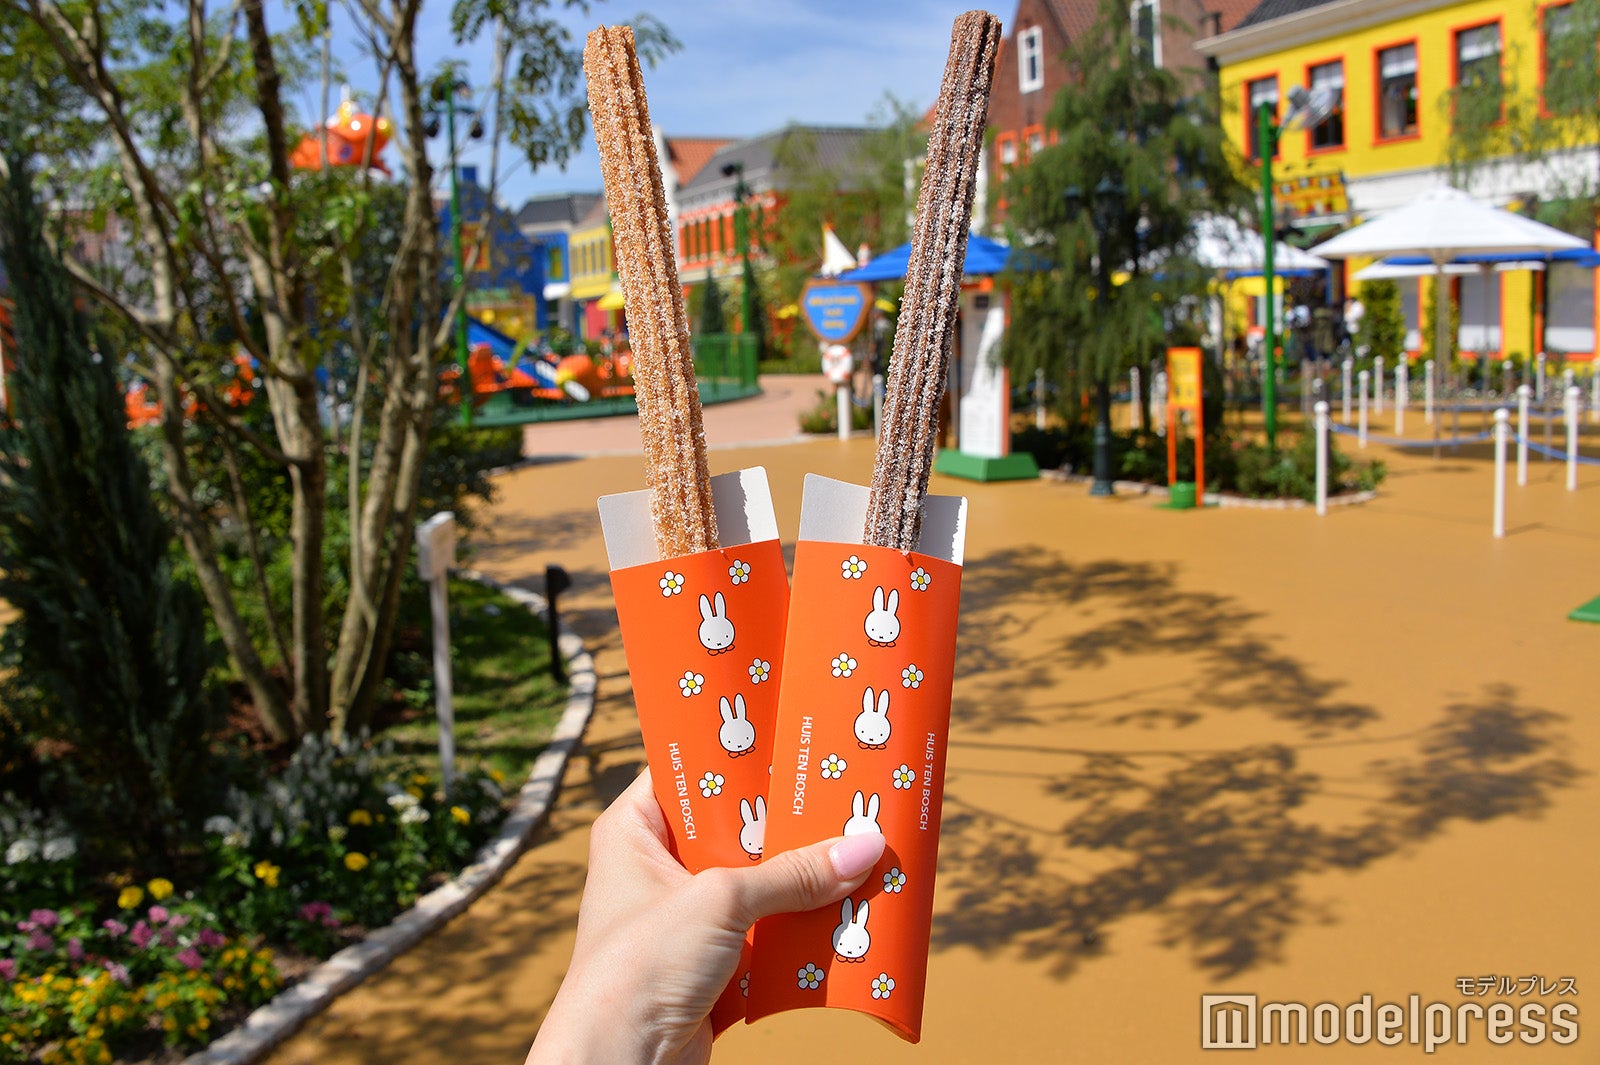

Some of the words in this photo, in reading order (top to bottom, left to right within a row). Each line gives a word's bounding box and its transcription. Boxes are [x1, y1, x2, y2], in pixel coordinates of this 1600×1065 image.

[801, 716, 813, 745] HUIS
[668, 742, 684, 771] HUIS
[797, 747, 809, 771] TEN
[925, 732, 936, 761] HUIS
[675, 772, 689, 797] TEN
[923, 763, 933, 786] TEN
[792, 773, 807, 815] BOSCH
[679, 798, 697, 840] BOSCH
[919, 789, 931, 830] BOSCH
